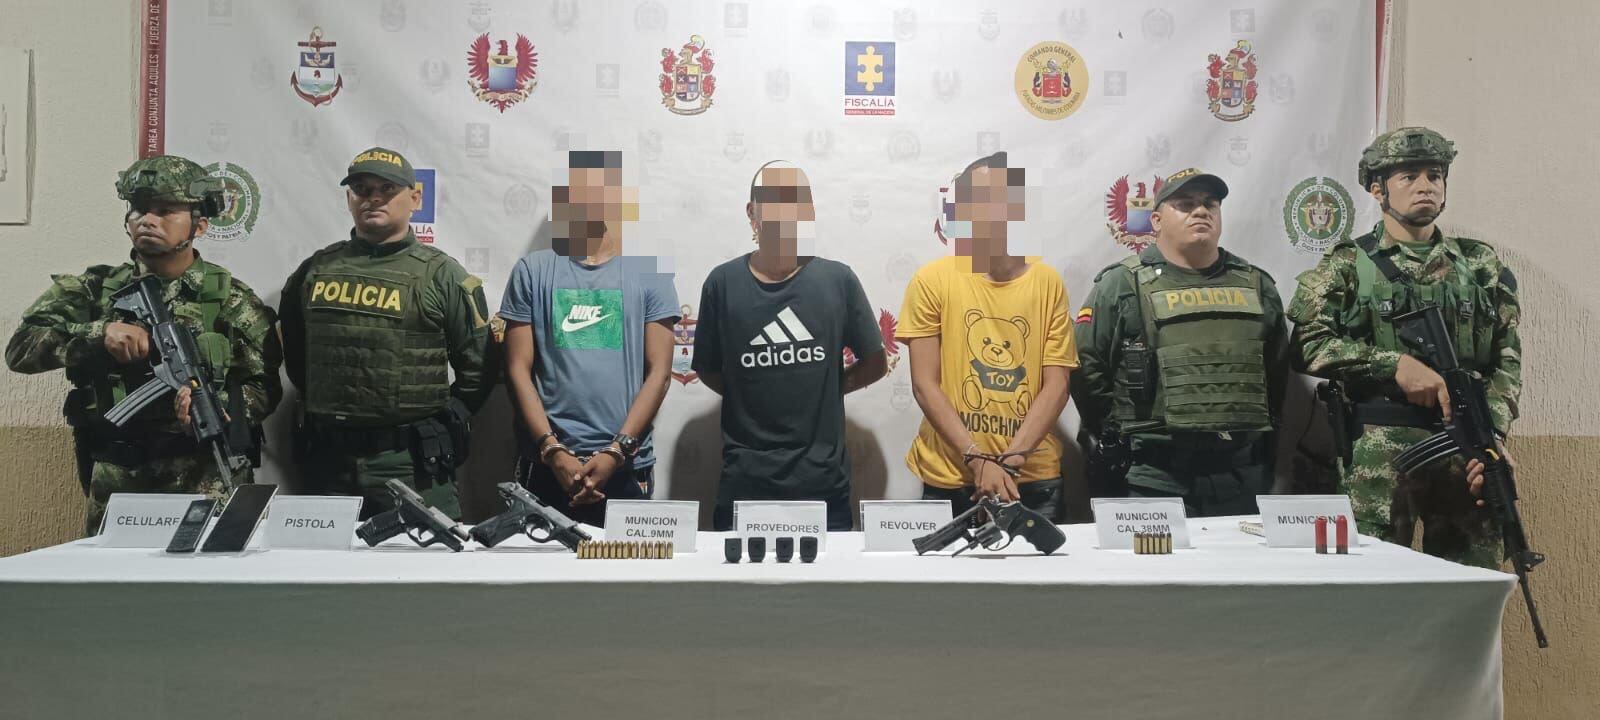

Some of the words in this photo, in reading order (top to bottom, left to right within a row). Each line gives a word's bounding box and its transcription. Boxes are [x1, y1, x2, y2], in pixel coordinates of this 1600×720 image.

[151, 3, 160, 13] DE
[150, 16, 160, 45] FUERZA
[1027, 46, 1053, 63] COMANDO
[1053, 46, 1077, 63] GENERAL
[149, 53, 160, 86] AQUILES
[149, 87, 159, 126] CONJUNTA
[844, 97, 895, 107] FISCALÍA
[148, 128, 158, 153] TAREA
[351, 151, 402, 167] POLICIA
[312, 281, 401, 311] POLICIA
[1166, 288, 1249, 311] POLICIA
[568, 305, 603, 320] NIKE
[741, 344, 825, 368] adidas
[986, 371, 1015, 387] TOY
[960, 411, 1025, 438] MOSCHIN
[285, 518, 335, 529] PISTOLA
[625, 516, 678, 526] MUNICION
[1115, 512, 1168, 521] MUNICION
[626, 528, 674, 538] CAL.9MM
[746, 523, 820, 534] PROVEDORES
[880, 520, 937, 531] REVOLVER
